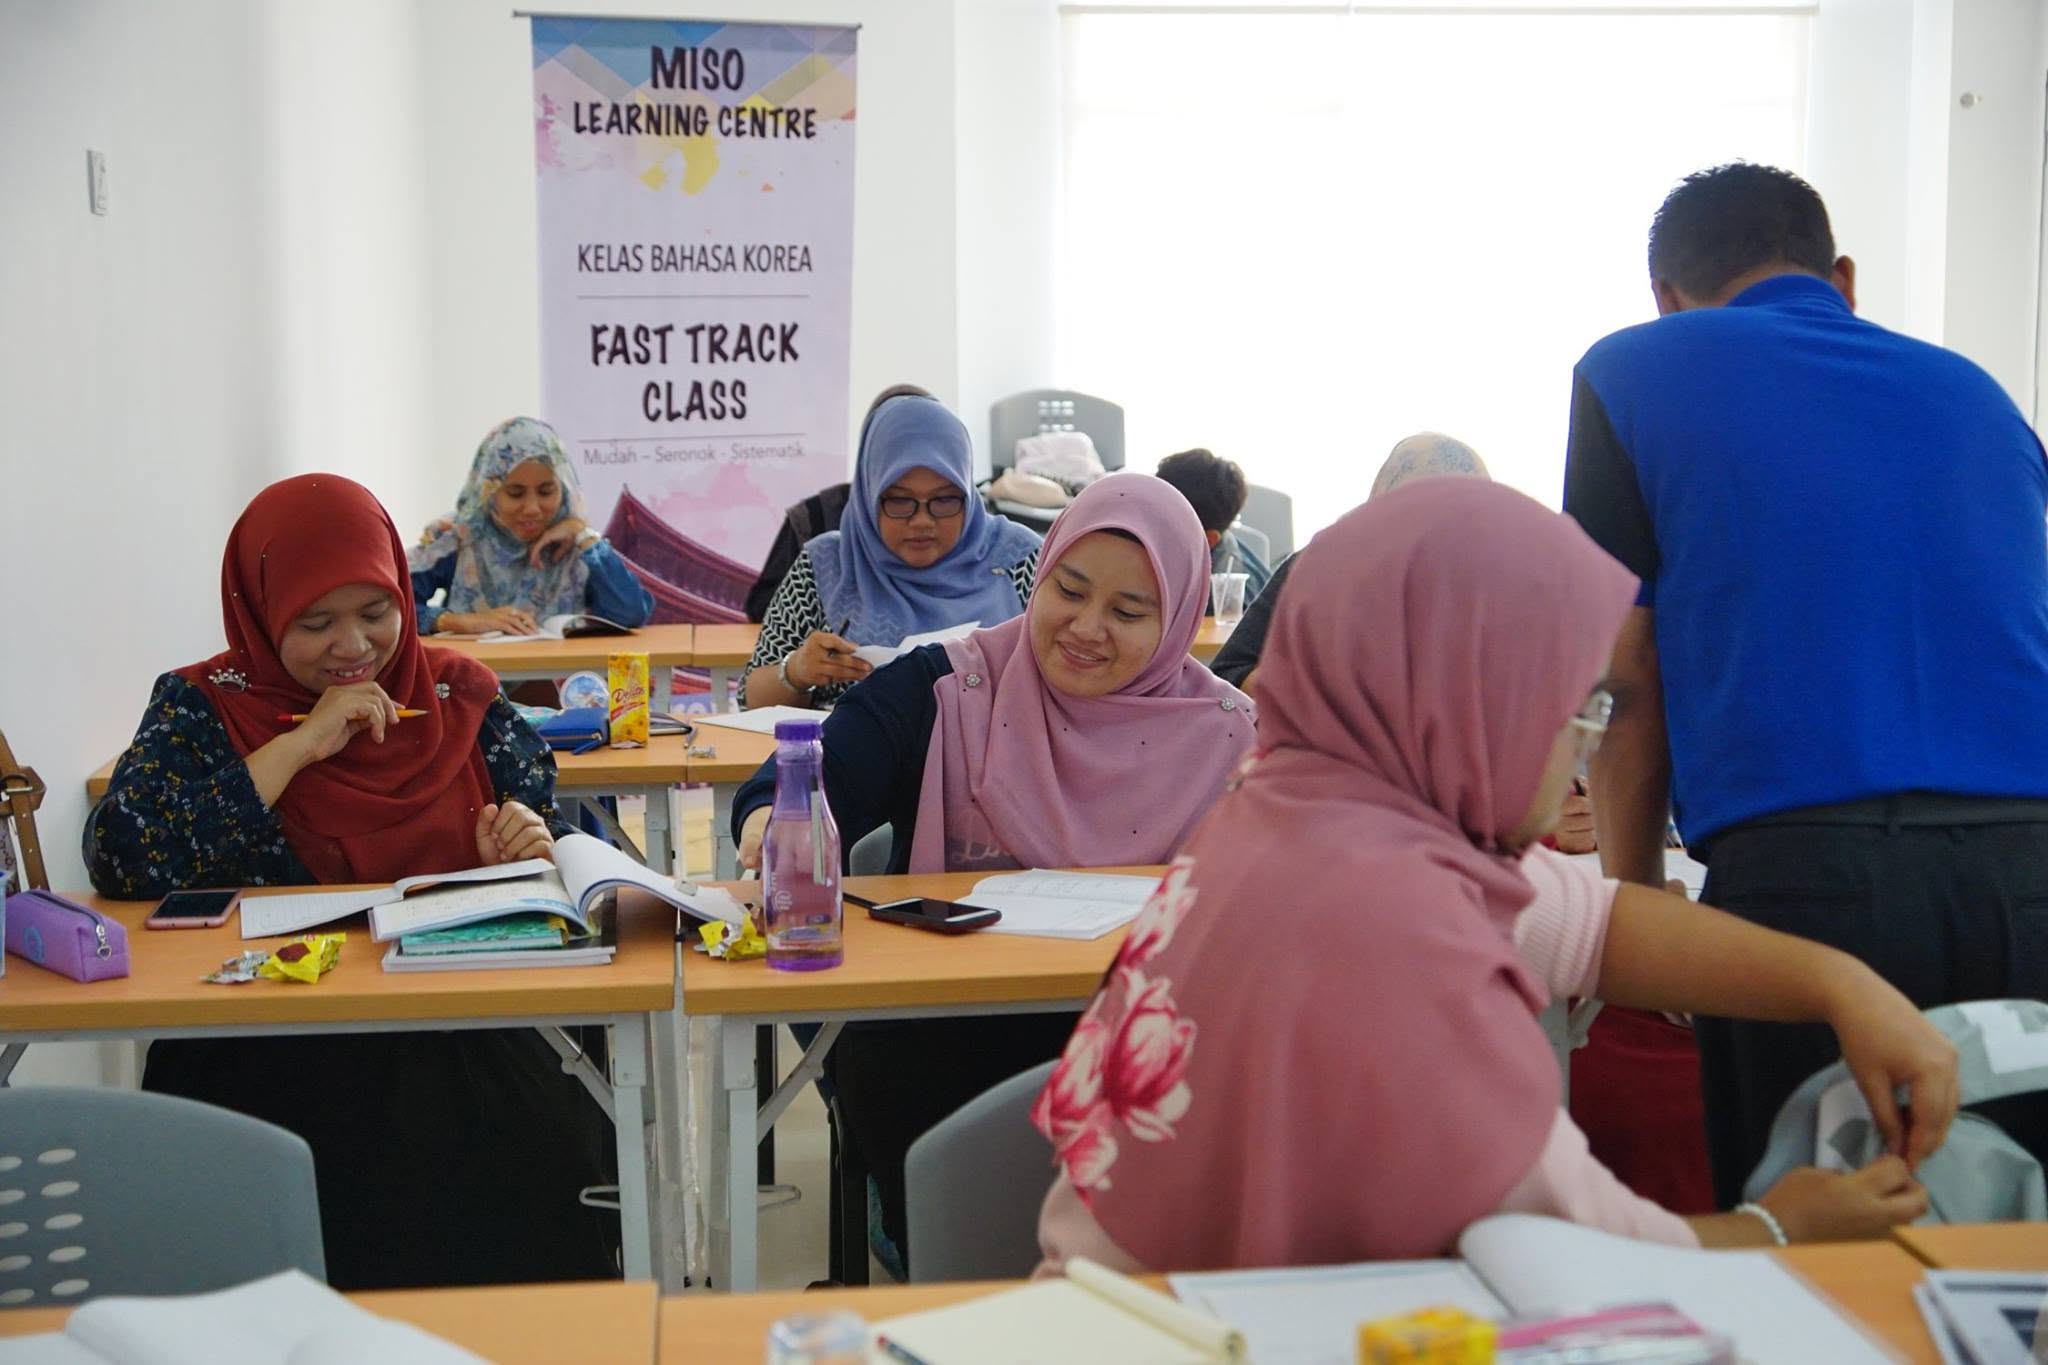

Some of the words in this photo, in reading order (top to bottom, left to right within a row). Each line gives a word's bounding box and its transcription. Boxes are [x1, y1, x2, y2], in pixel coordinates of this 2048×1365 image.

[651, 46, 744, 90] MISO
[574, 102, 709, 137] LEARNING
[718, 108, 817, 139] CENTRE
[578, 245, 643, 273] KELAS
[651, 245, 736, 273] BAHASA
[743, 246, 812, 273] KOREA
[591, 323, 674, 366] FAST
[685, 321, 799, 363] TRACK
[643, 379, 747, 422] CLASS
[583, 441, 638, 466] Mudah
[655, 445, 716, 463] Seronok
[730, 441, 805, 460] Sistematik
